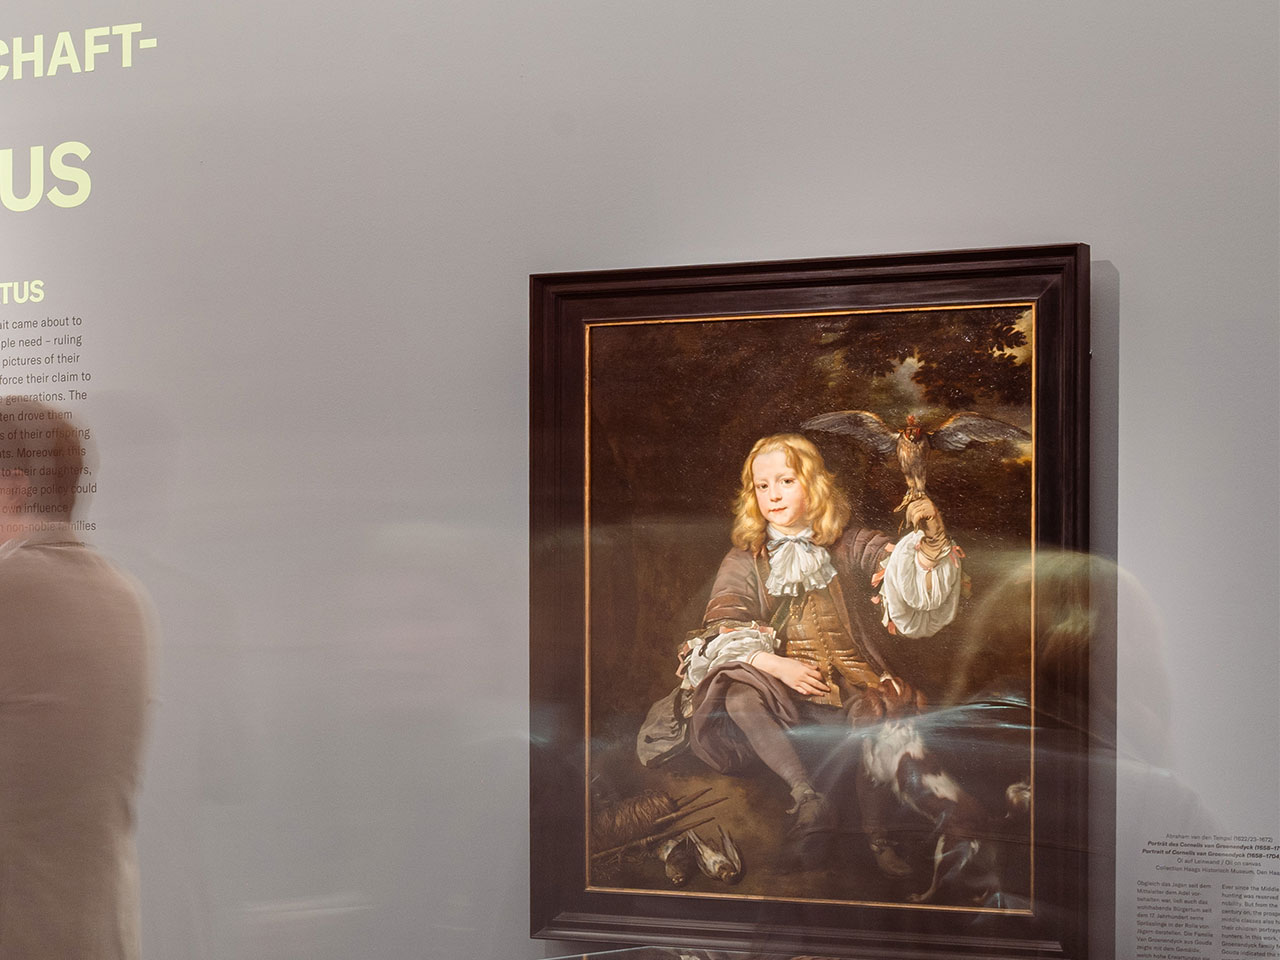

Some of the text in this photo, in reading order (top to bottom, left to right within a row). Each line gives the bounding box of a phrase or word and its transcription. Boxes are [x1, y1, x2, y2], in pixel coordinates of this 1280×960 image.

[11, 320, 38, 329] came
[41, 316, 69, 328] about
[72, 316, 82, 326] to
[18, 336, 42, 348] need
[53, 335, 82, 347] ruling
[2, 356, 42, 369] pictures
[44, 354, 54, 365] of
[57, 353, 80, 364] their
[26, 373, 49, 384] their
[51, 372, 78, 383] claim
[81, 372, 92, 382] to
[5, 392, 66, 406] generations.
[68, 390, 87, 401] The
